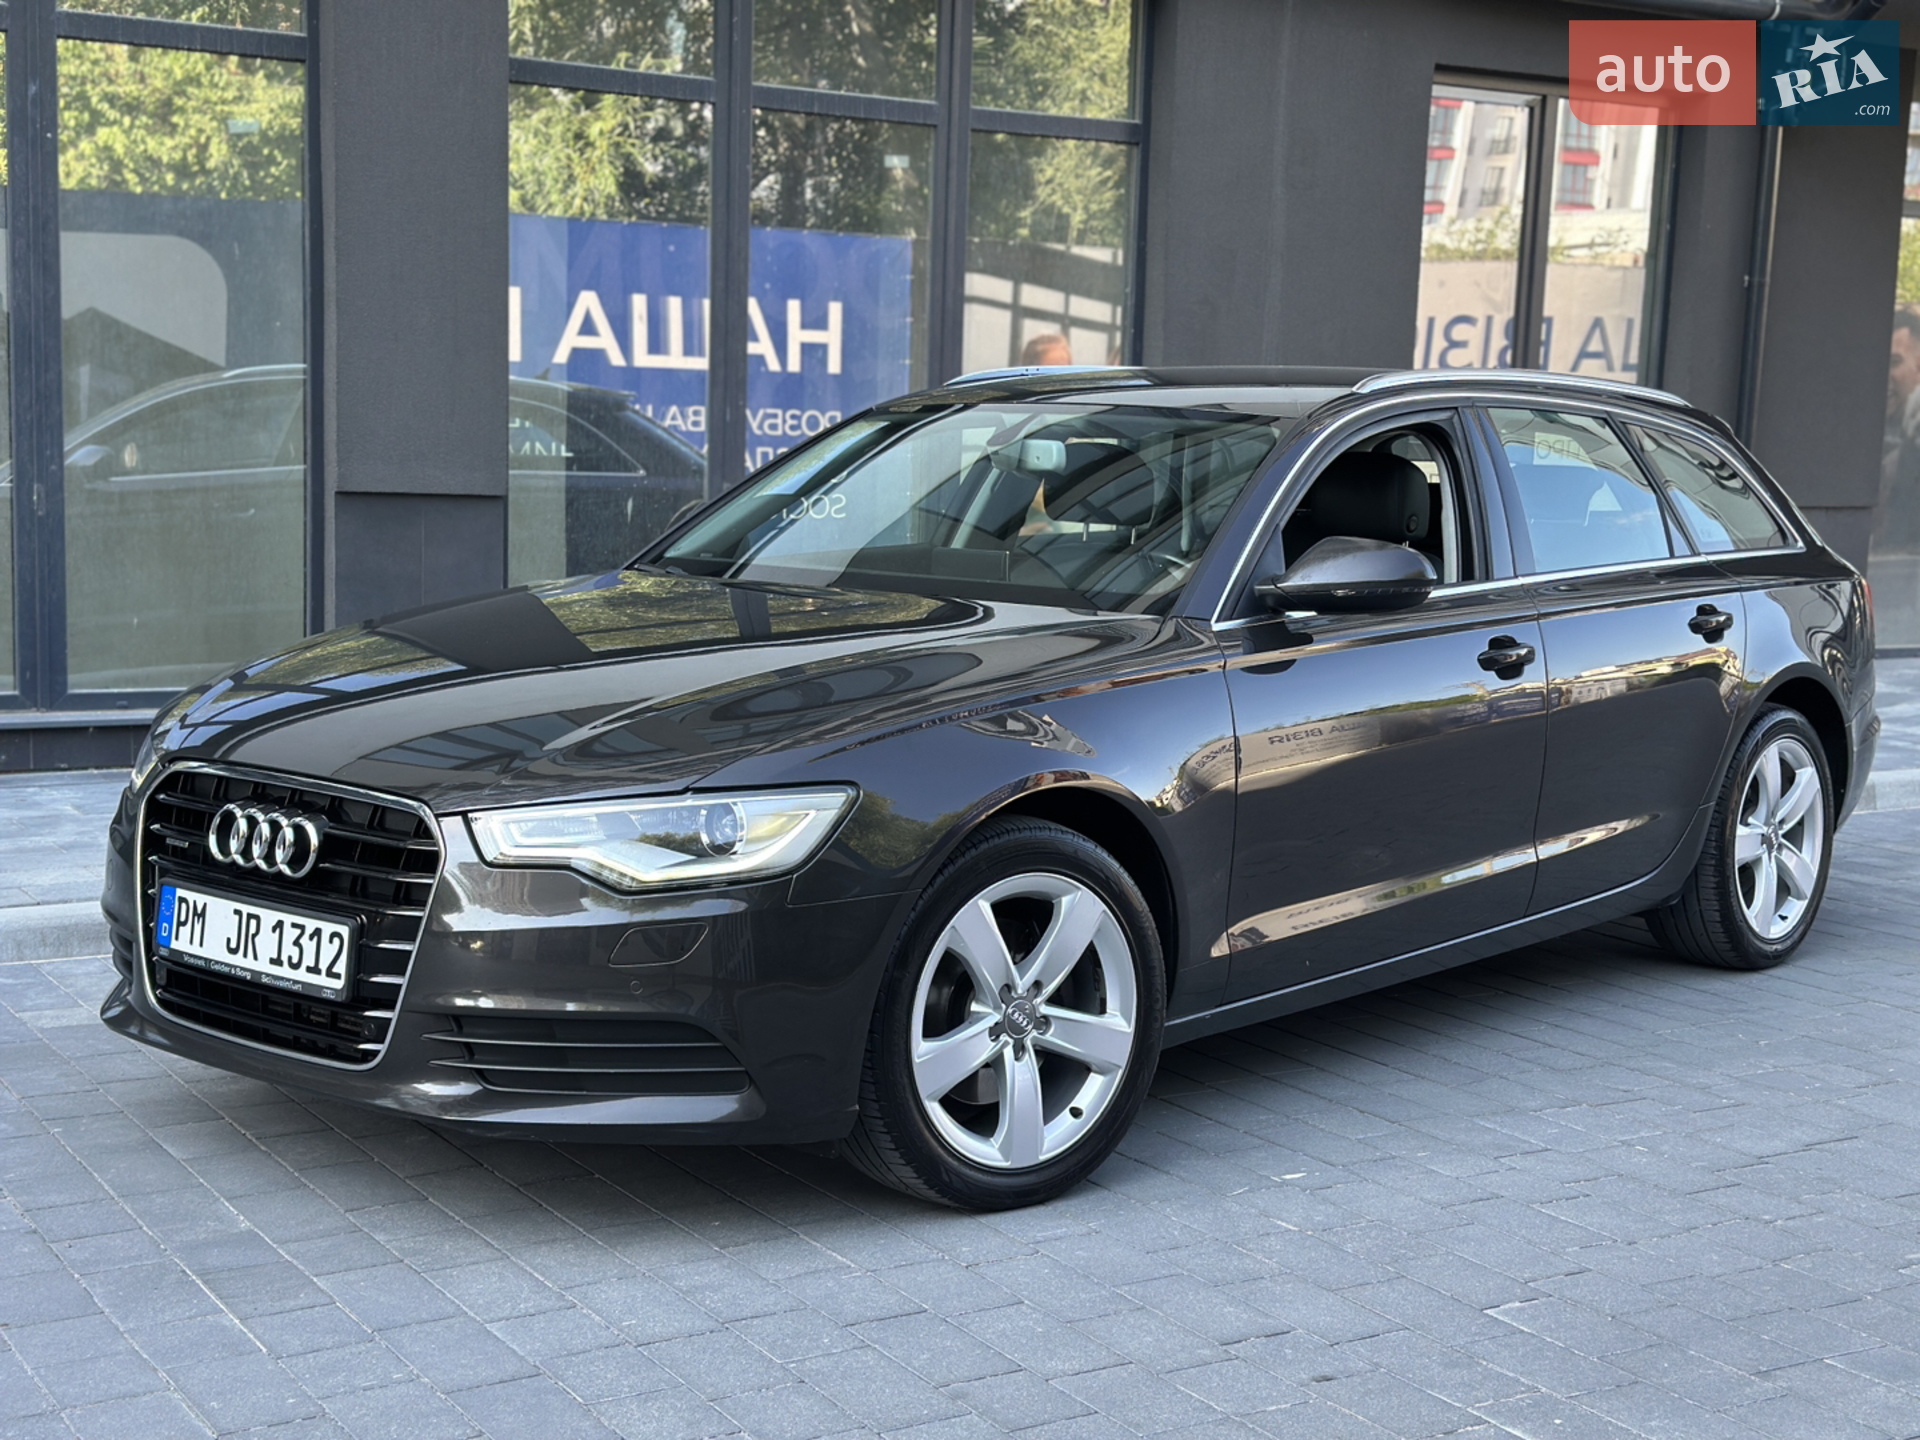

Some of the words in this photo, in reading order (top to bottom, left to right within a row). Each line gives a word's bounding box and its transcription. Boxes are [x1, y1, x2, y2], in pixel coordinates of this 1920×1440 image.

[161, 923, 169, 937] D
[174, 896, 207, 948] PM
[226, 908, 261, 961] JR
[268, 919, 345, 980] 1312
